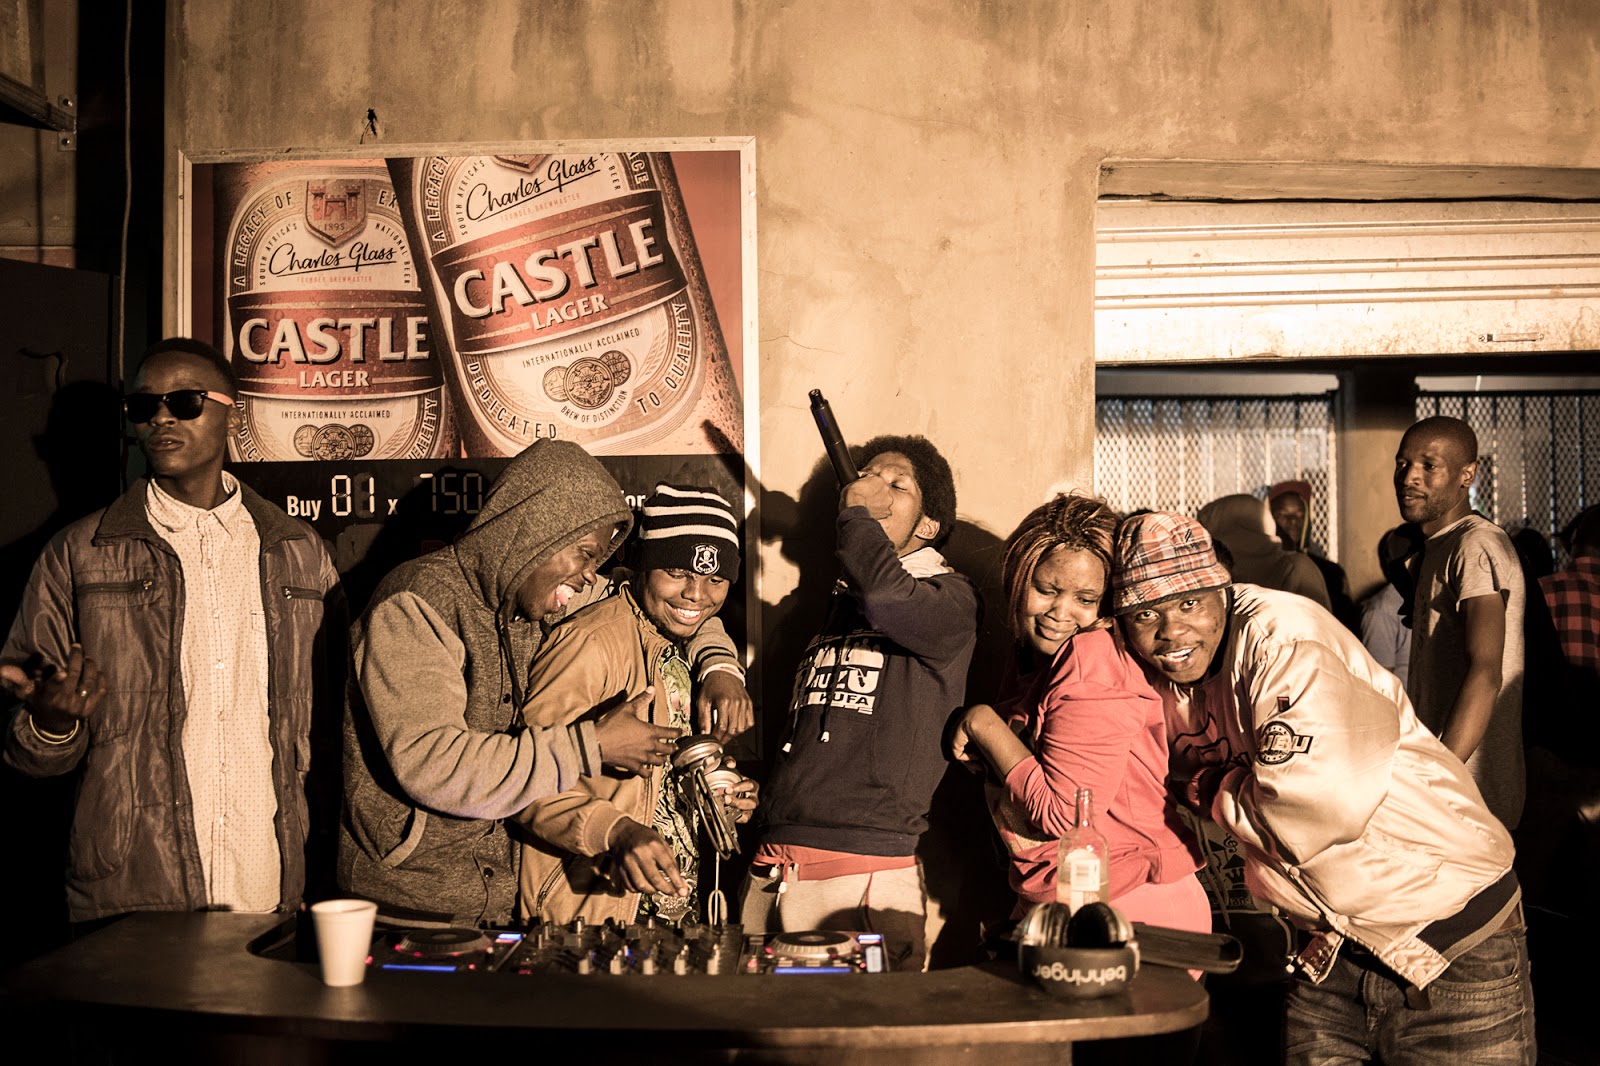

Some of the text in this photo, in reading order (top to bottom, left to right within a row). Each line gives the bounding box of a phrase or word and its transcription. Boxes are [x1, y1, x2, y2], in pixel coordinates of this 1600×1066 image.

[466, 156, 598, 221] Charles Glass
[608, 165, 621, 190] BEER
[275, 191, 292, 209] OF
[427, 155, 449, 241] A LEGACY
[236, 206, 267, 267] LEGACY
[324, 222, 345, 232] 1895
[456, 204, 468, 236] SOUTH
[259, 222, 299, 286] SOUTH AFRICA'S
[268, 241, 397, 275] Charles Glass
[375, 222, 411, 284] NATIONAL BEER
[453, 217, 665, 320] CASTLE
[235, 275, 246, 287] A
[530, 293, 611, 331] LAGER
[238, 316, 431, 364] CASTLE
[522, 341, 594, 369] INTERNATIONALLY
[596, 327, 641, 348] ACCLAIMED
[299, 370, 370, 388] LAGER
[468, 362, 558, 439] DEDICATED
[636, 391, 661, 414] TO
[664, 303, 691, 390] QUALITY
[281, 410, 391, 420] INTERNATIONALLY ACCLAIMED
[560, 389, 628, 424] BREW OF DISTINCTION
[286, 472, 647, 521] Buy 01 x 750 or
[1031, 961, 1127, 987] behringer
